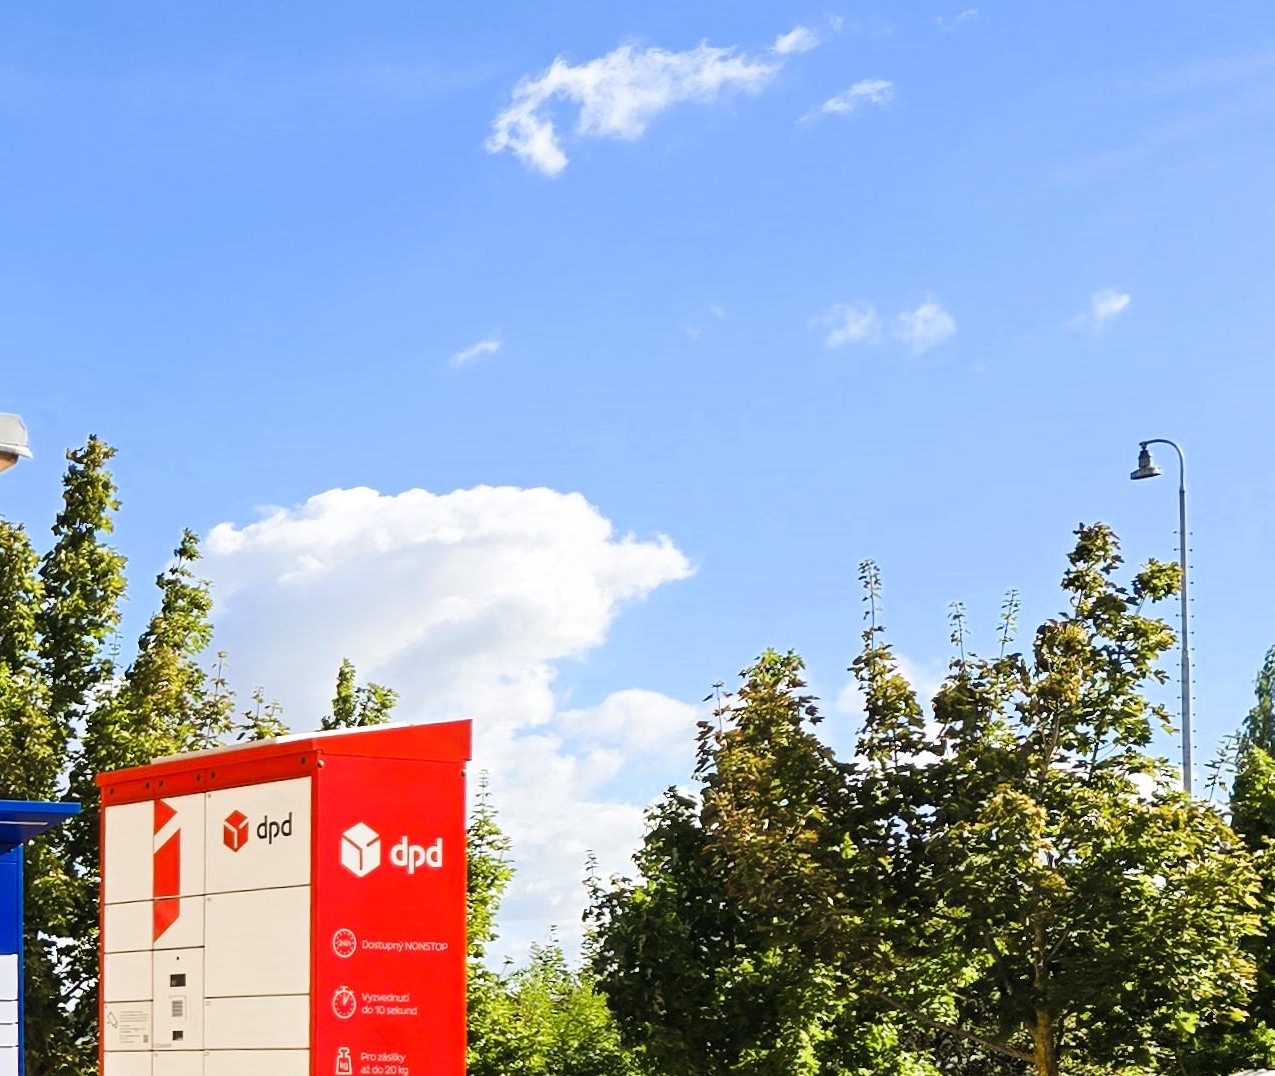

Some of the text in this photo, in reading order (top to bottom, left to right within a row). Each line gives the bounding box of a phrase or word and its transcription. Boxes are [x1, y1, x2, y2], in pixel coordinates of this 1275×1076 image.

[257, 812, 292, 844] dpd
[390, 836, 444, 875] dpd
[361, 940, 448, 952] Dostupný NONSTOP
[361, 993, 411, 1003] Vyzvednutí
[361, 1005, 418, 1015] do 10 sekund
[361, 1052, 406, 1063] Pro zásilky
[361, 1065, 409, 1076] až do 20 kg
